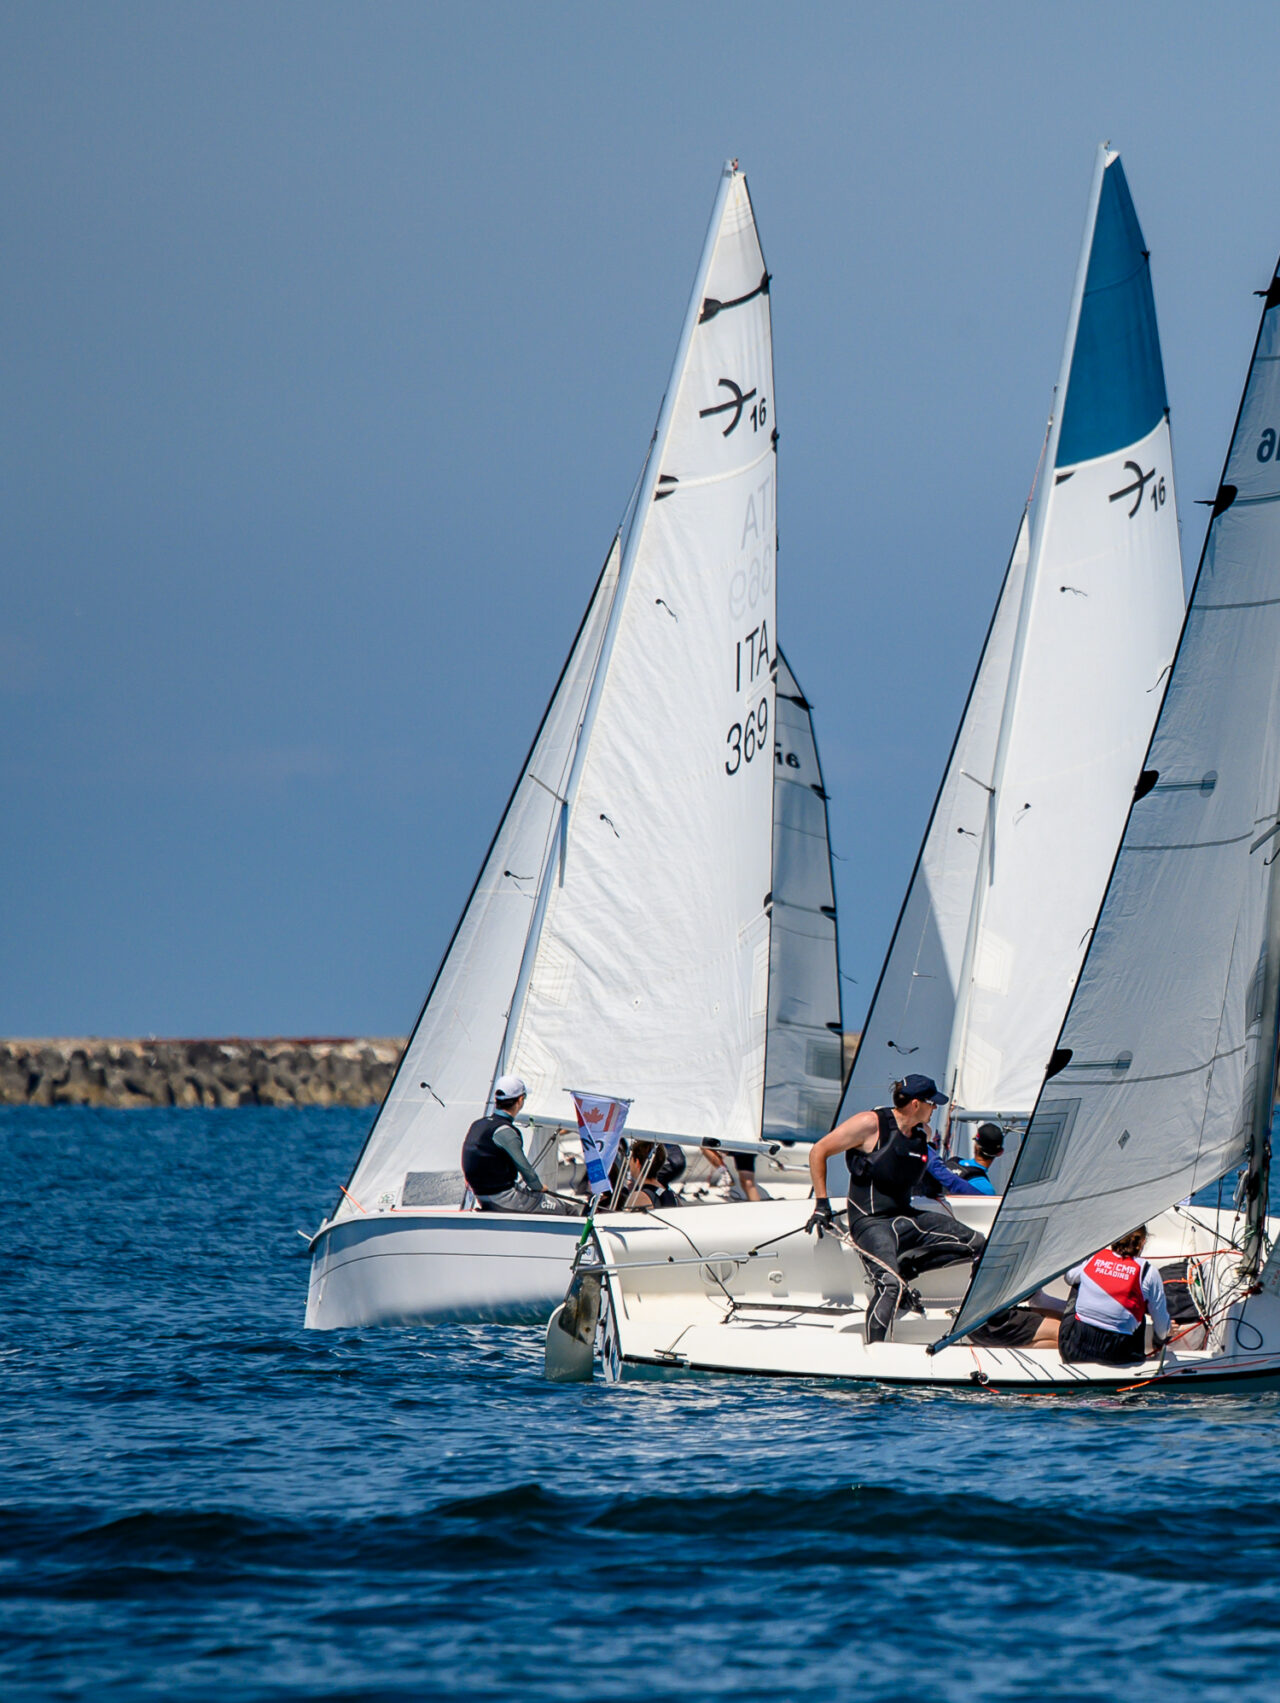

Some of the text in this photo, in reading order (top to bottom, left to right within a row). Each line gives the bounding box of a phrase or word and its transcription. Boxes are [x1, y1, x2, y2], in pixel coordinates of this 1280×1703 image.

[750, 398, 767, 433] 16
[1150, 476, 1166, 512] 16
[735, 619, 770, 692] ITA
[725, 697, 769, 776] 369
[775, 752, 800, 769] 16
[1095, 1268, 1129, 1280] PALADINS
